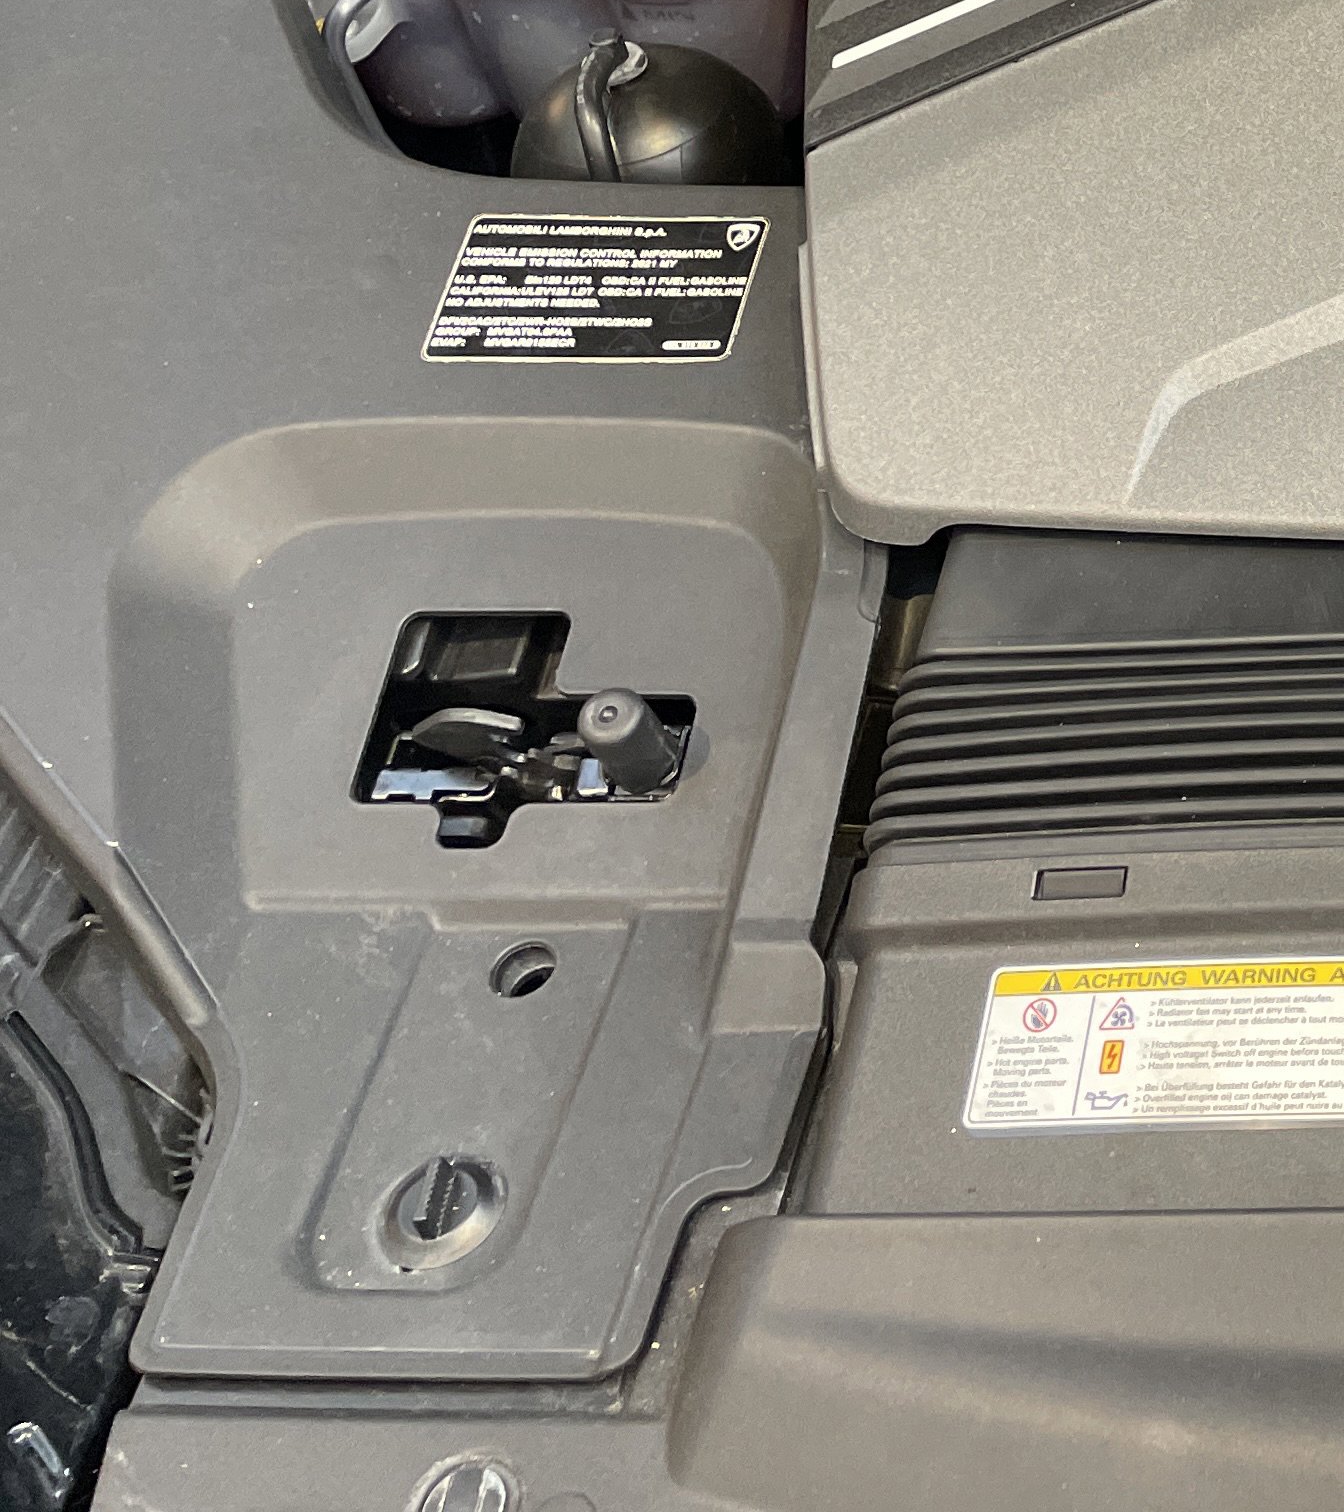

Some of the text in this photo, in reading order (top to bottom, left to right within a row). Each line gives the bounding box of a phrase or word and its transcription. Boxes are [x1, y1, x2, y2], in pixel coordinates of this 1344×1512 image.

[473, 225, 548, 235] AUTOMOBILI
[549, 226, 633, 236] LAMBORGHINI
[465, 246, 723, 259] VEHICLE EMISSION CONTROL INFORMATION
[461, 257, 527, 267] CONFORMS
[529, 257, 545, 267] TO
[660, 259, 678, 268] MY
[445, 297, 464, 306] NO
[464, 297, 549, 307] ADJUSTMENTS
[1073, 970, 1187, 989] ACHTUNG
[1201, 967, 1317, 985] WARNING
[1231, 996, 1252, 1004] kann
[1254, 995, 1291, 1005] jederzeit
[1157, 1008, 1194, 1016] Radiator
[1212, 1008, 1231, 1016] may
[1168, 1018, 1214, 1026] ventilateur
[1216, 1018, 1236, 1027] peut
[1251, 1016, 1299, 1025] déclencher
[1301, 1016, 1306, 1024] à
[1222, 1039, 1237, 1047] vor
[1239, 1038, 1280, 1046] Berühren
[1150, 1051, 1170, 1060] High
[1211, 1049, 1241, 1058] Switch
[1243, 1048, 1256, 1057] off
[1258, 1049, 1288, 1058] engine
[1290, 1048, 1319, 1056] before
[1013, 1059, 1042, 1067] engine
[1148, 1061, 1174, 1069] Haute
[1256, 1059, 1288, 1067] moteur
[1290, 1058, 1315, 1067] avant
[1317, 1058, 1329, 1066] de
[993, 1069, 1026, 1077] Moving
[1144, 1083, 1158, 1091] Bei
[1216, 1081, 1249, 1090] besteht
[1251, 1080, 1281, 1089] Gefahr
[1284, 1080, 1297, 1088] für
[1299, 1080, 1316, 1088] den
[1143, 1093, 1187, 1102] Overfilled
[1187, 1093, 1218, 1102] engine
[1252, 1092, 1288, 1101] damage
[1141, 1105, 1154, 1113] Un
[1156, 1104, 1211, 1115] remplissage
[1213, 1102, 1249, 1111] excessif
[1284, 1102, 1304, 1111] peut
[1306, 1101, 1329, 1109] nuire
